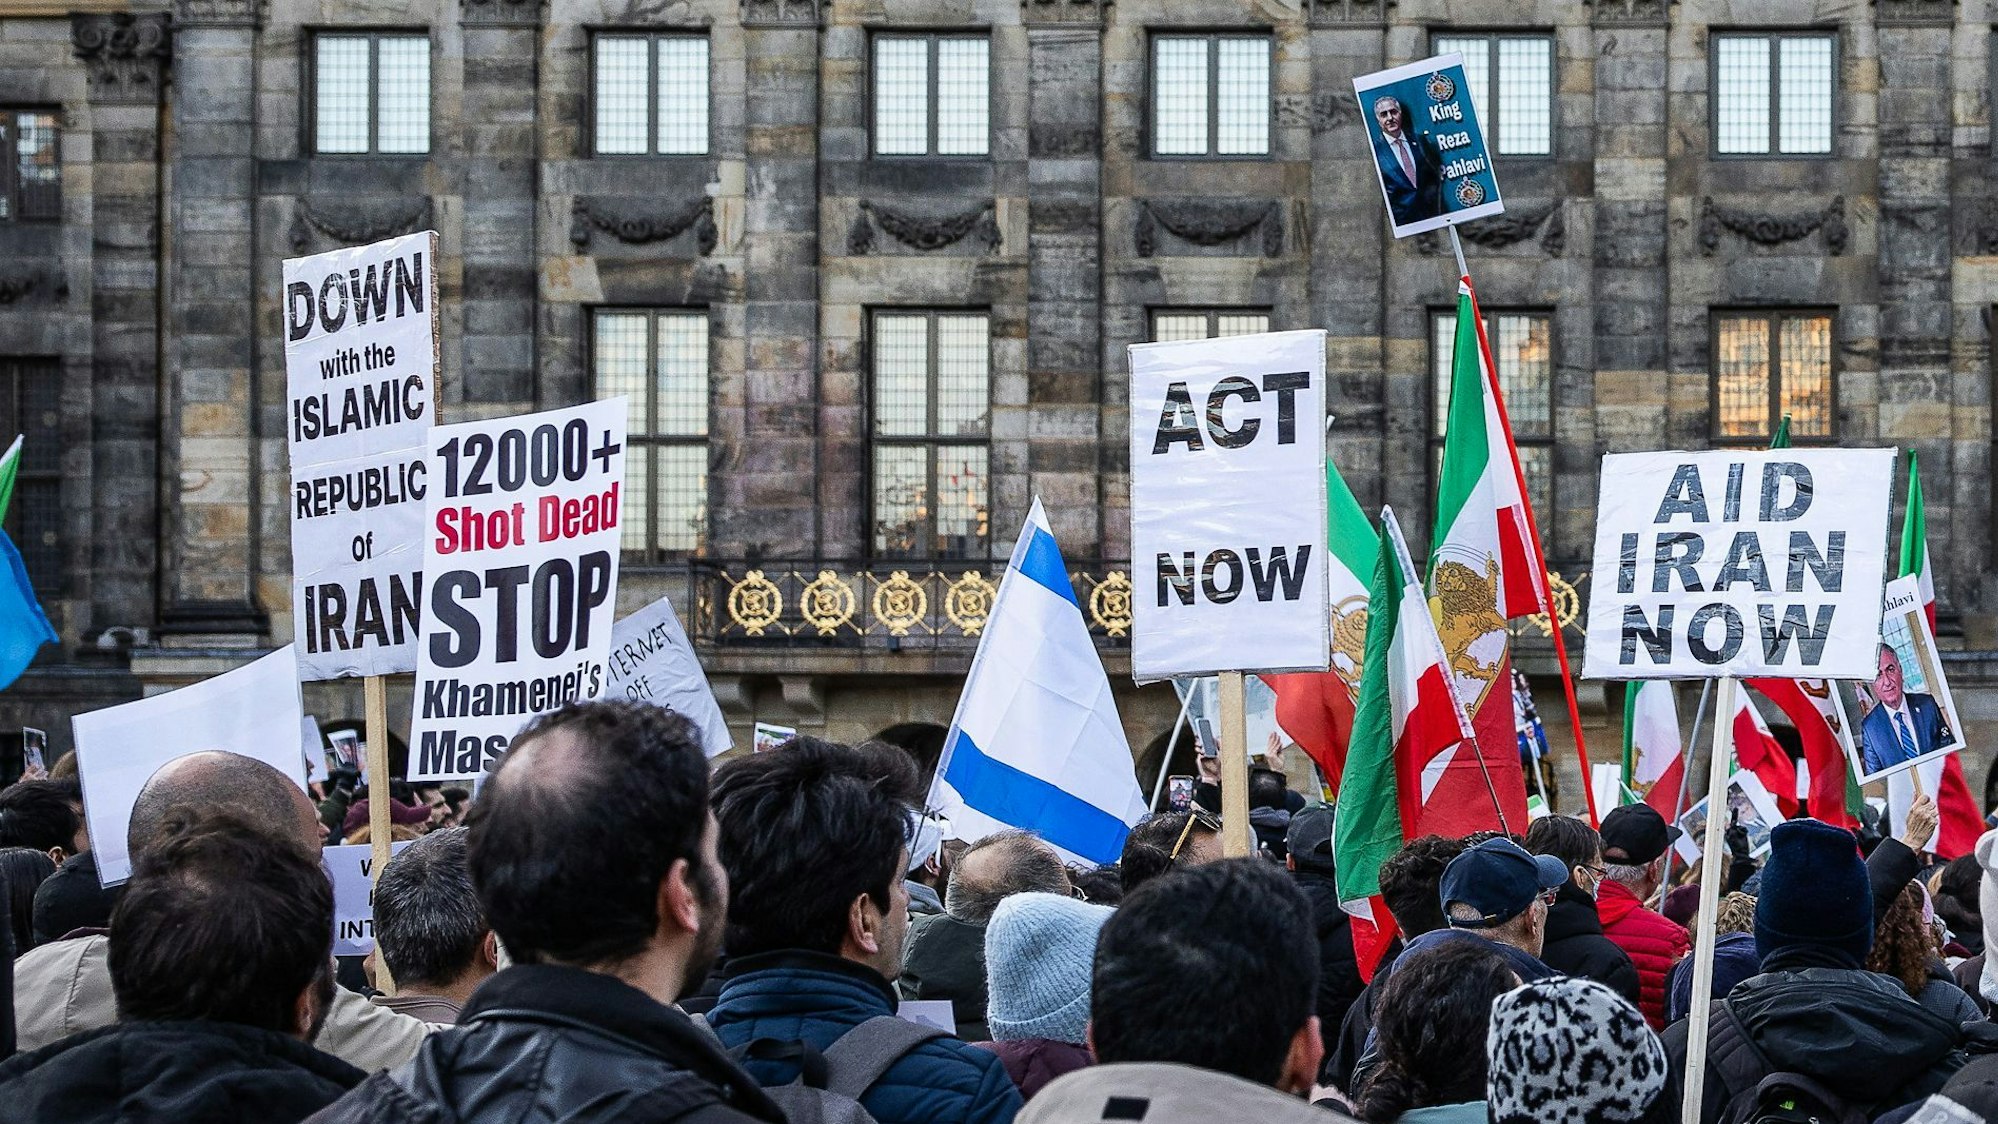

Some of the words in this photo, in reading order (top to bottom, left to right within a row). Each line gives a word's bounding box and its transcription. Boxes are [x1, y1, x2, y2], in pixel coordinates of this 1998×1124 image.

[1429, 101, 1462, 121] King
[1436, 131, 1471, 150] Reza
[287, 252, 423, 341] DOWN
[320, 348, 360, 379] with
[364, 343, 395, 370] the
[294, 375, 424, 442] ISLAMIC
[1152, 371, 1310, 455] ACT
[437, 418, 621, 498] 12000+
[296, 460, 427, 519] REPUBLIC
[435, 502, 525, 554] Shot
[539, 481, 619, 542] Dead
[1653, 462, 1814, 524] AID
[352, 531, 373, 561] of
[1156, 545, 1312, 607] NOW
[1617, 531, 1846, 593] IRAN
[305, 571, 423, 653] IRAN
[429, 550, 612, 668] STOP
[1619, 603, 1837, 666] NOW
[422, 660, 601, 719] Khamenei's
[626, 675, 653, 701] OFF
